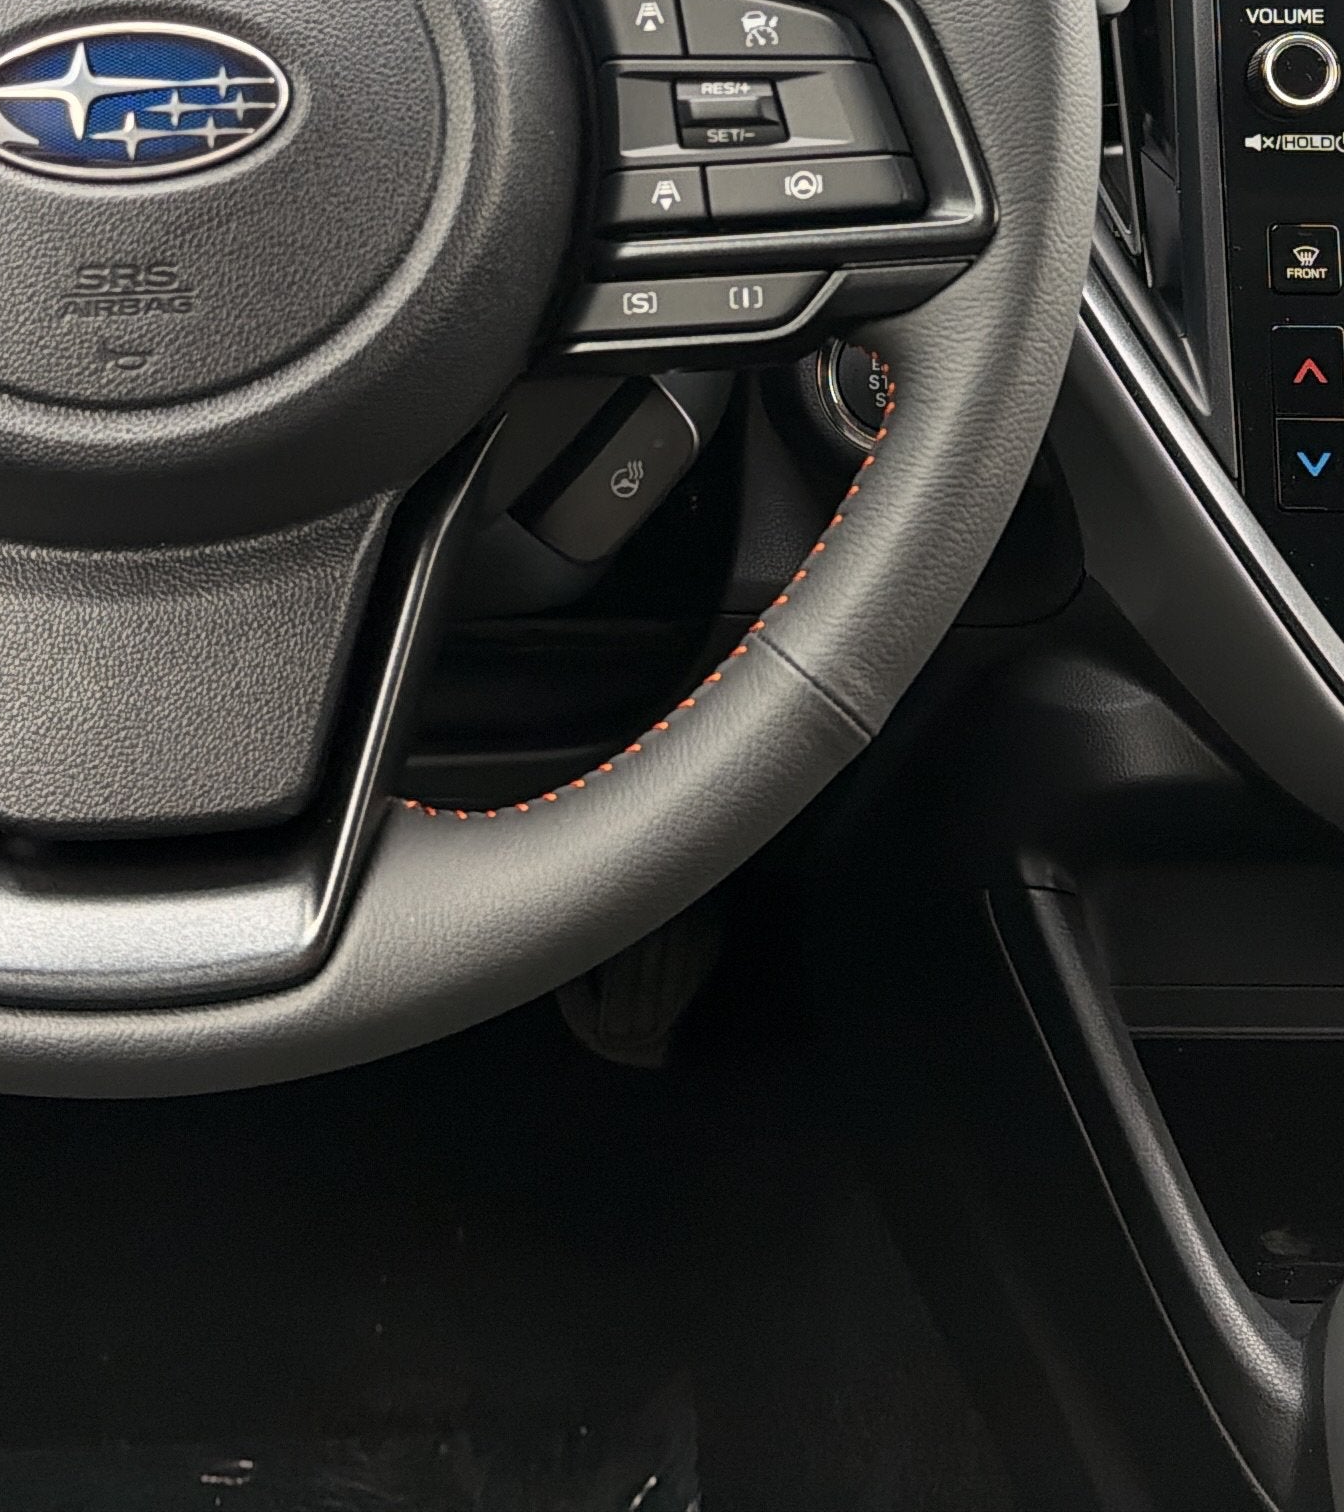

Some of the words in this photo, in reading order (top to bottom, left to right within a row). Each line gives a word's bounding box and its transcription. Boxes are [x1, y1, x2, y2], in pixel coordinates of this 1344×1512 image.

[1246, 8, 1325, 24] VOLUME
[701, 82, 751, 95] RES/+
[74, 265, 181, 292] SRS
[1286, 268, 1327, 280] FRONT
[58, 296, 195, 317] AIRBAG
